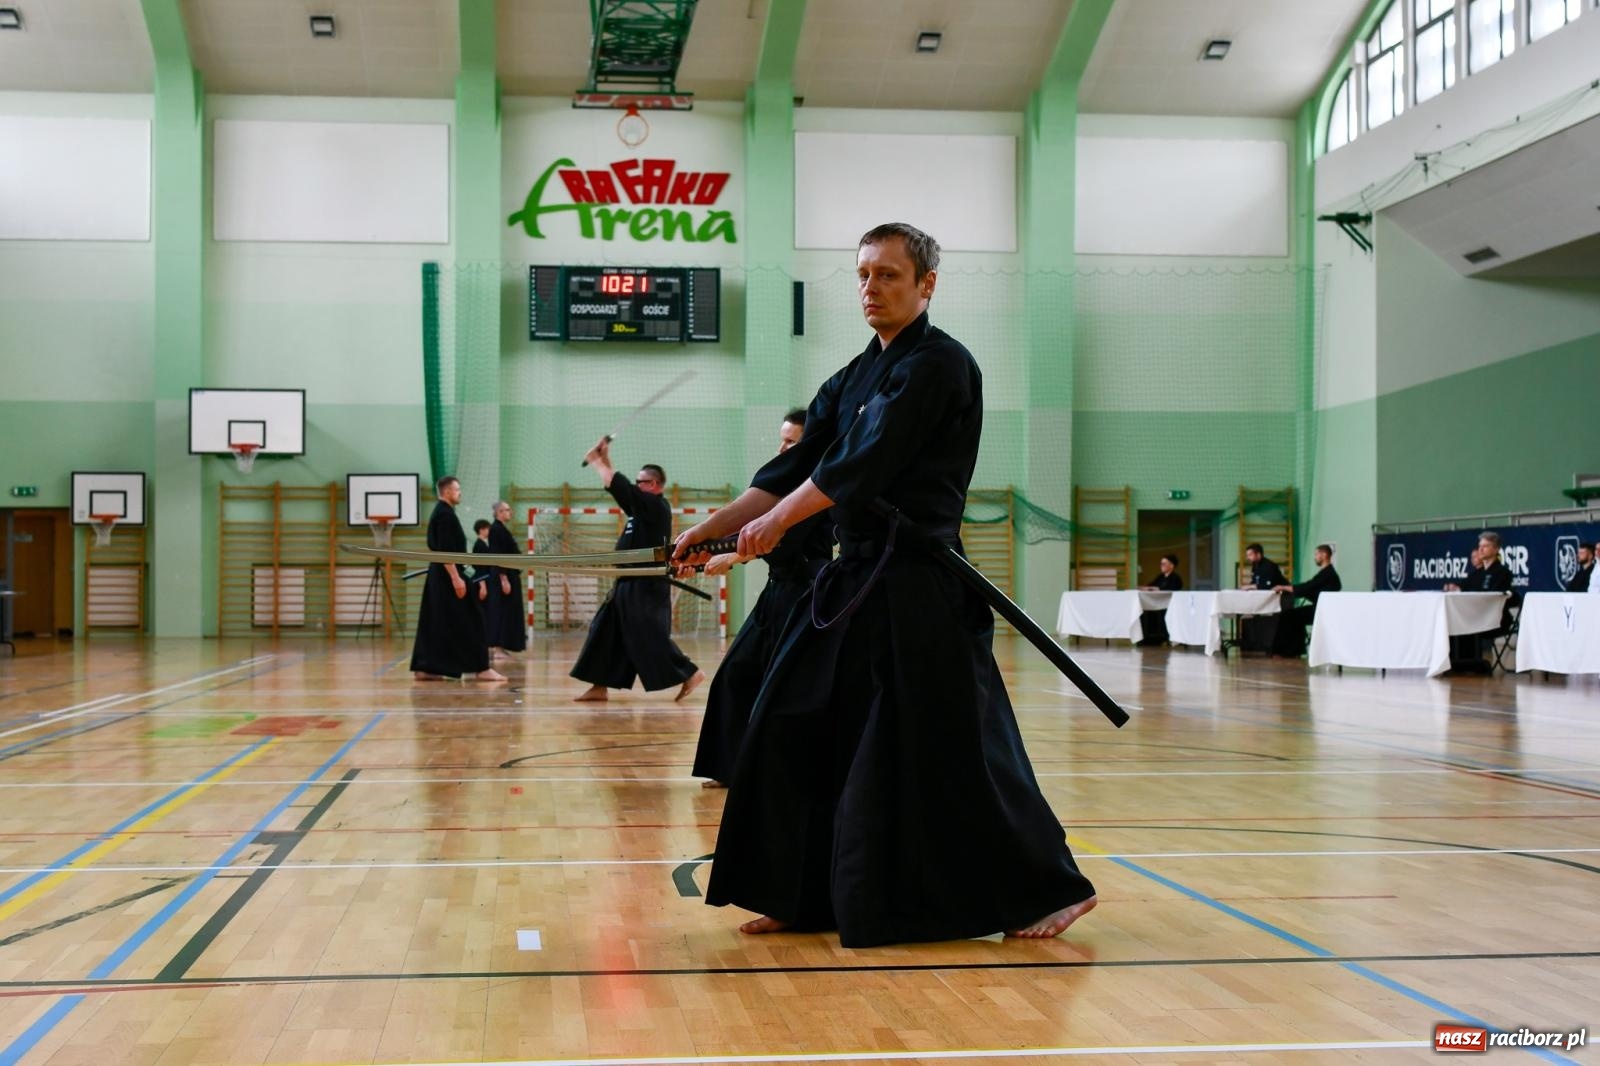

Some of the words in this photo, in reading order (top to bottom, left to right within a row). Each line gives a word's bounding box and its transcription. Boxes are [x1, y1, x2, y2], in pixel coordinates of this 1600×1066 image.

[558, 159, 731, 205] RAFAKO
[507, 158, 738, 243] Arena
[570, 304, 618, 315] GOSPODARZE
[642, 303, 670, 316] GOŚCIE
[1413, 553, 1468, 579] RACIBÓRZ
